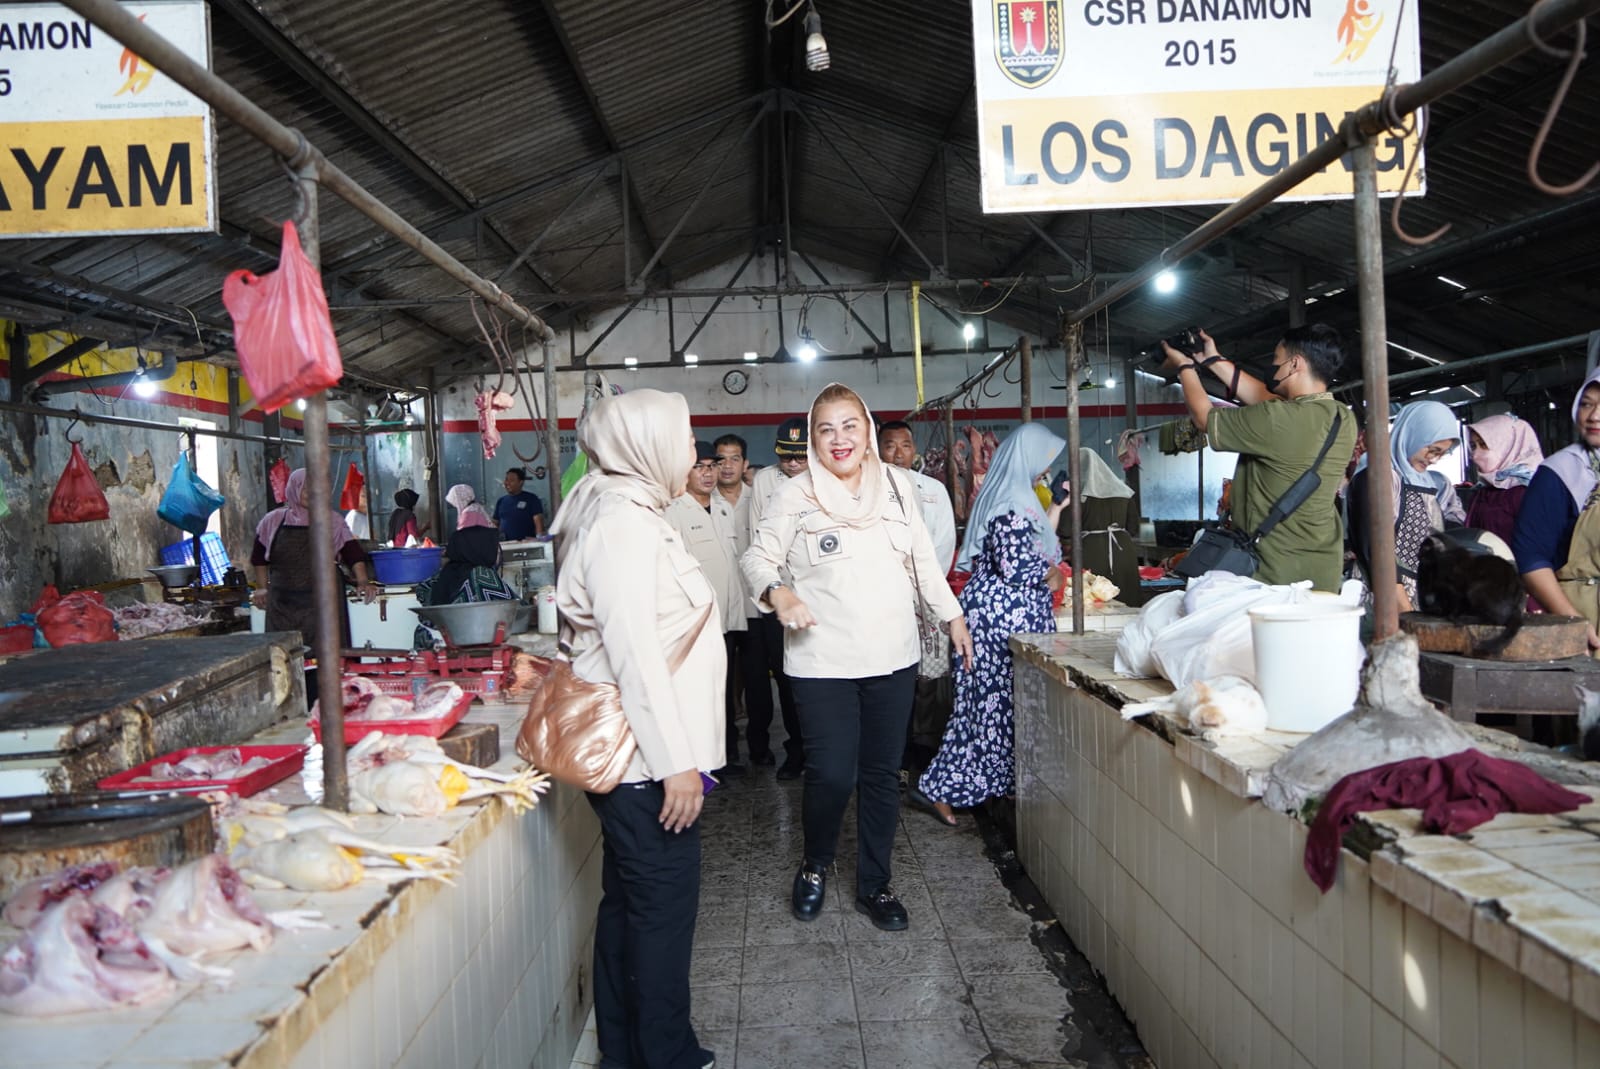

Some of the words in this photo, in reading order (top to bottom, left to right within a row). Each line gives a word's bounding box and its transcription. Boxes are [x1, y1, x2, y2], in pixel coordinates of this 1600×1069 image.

[1084, 0, 1146, 26] CSR
[1157, 0, 1312, 23] DANAMON
[1164, 38, 1237, 67] 2015
[1001, 119, 1132, 185] LOS
[0, 142, 193, 211] YAM
